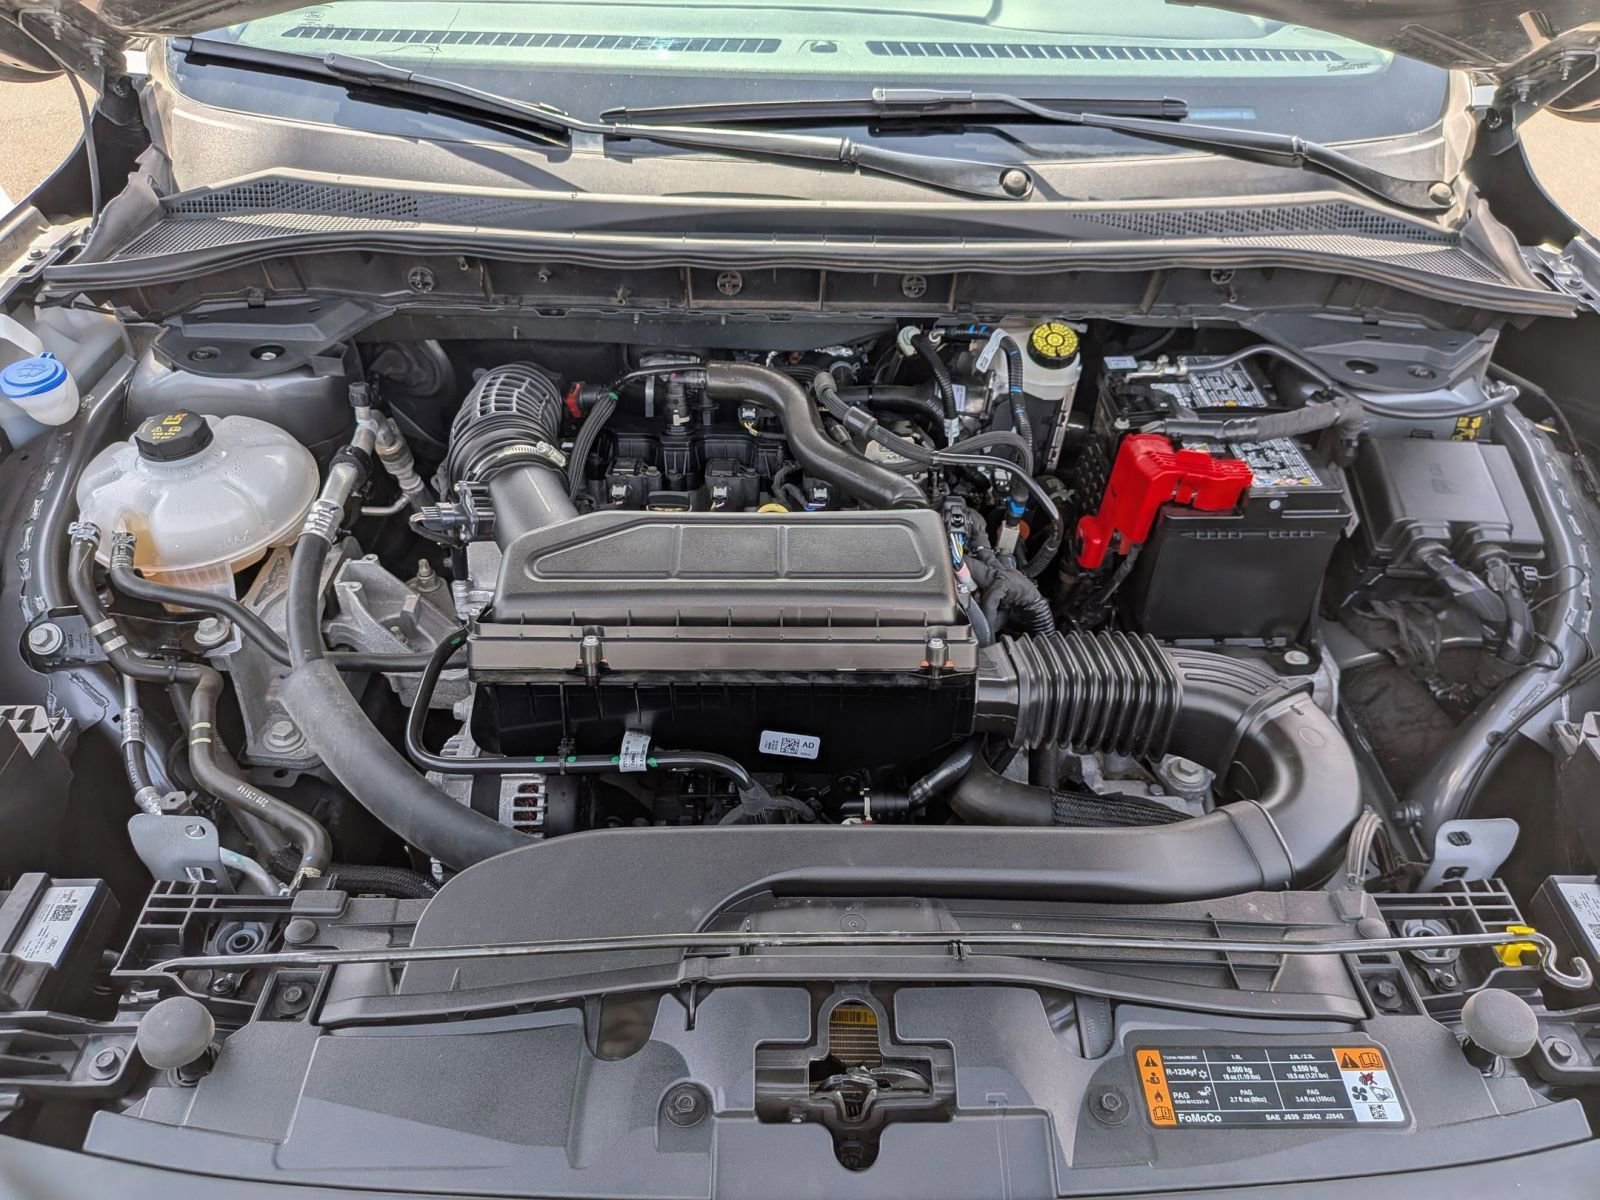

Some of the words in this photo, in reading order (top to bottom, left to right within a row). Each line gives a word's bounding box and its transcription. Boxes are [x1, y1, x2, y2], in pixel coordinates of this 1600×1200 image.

[802, 741, 815, 749] AD
[1166, 1068, 1198, 1077] R-1234yf
[1226, 1066, 1244, 1074] 0.500
[1244, 1066, 1253, 1075] kg
[1309, 1065, 1319, 1074] kg
[1178, 1113, 1222, 1123] FoMoCo
